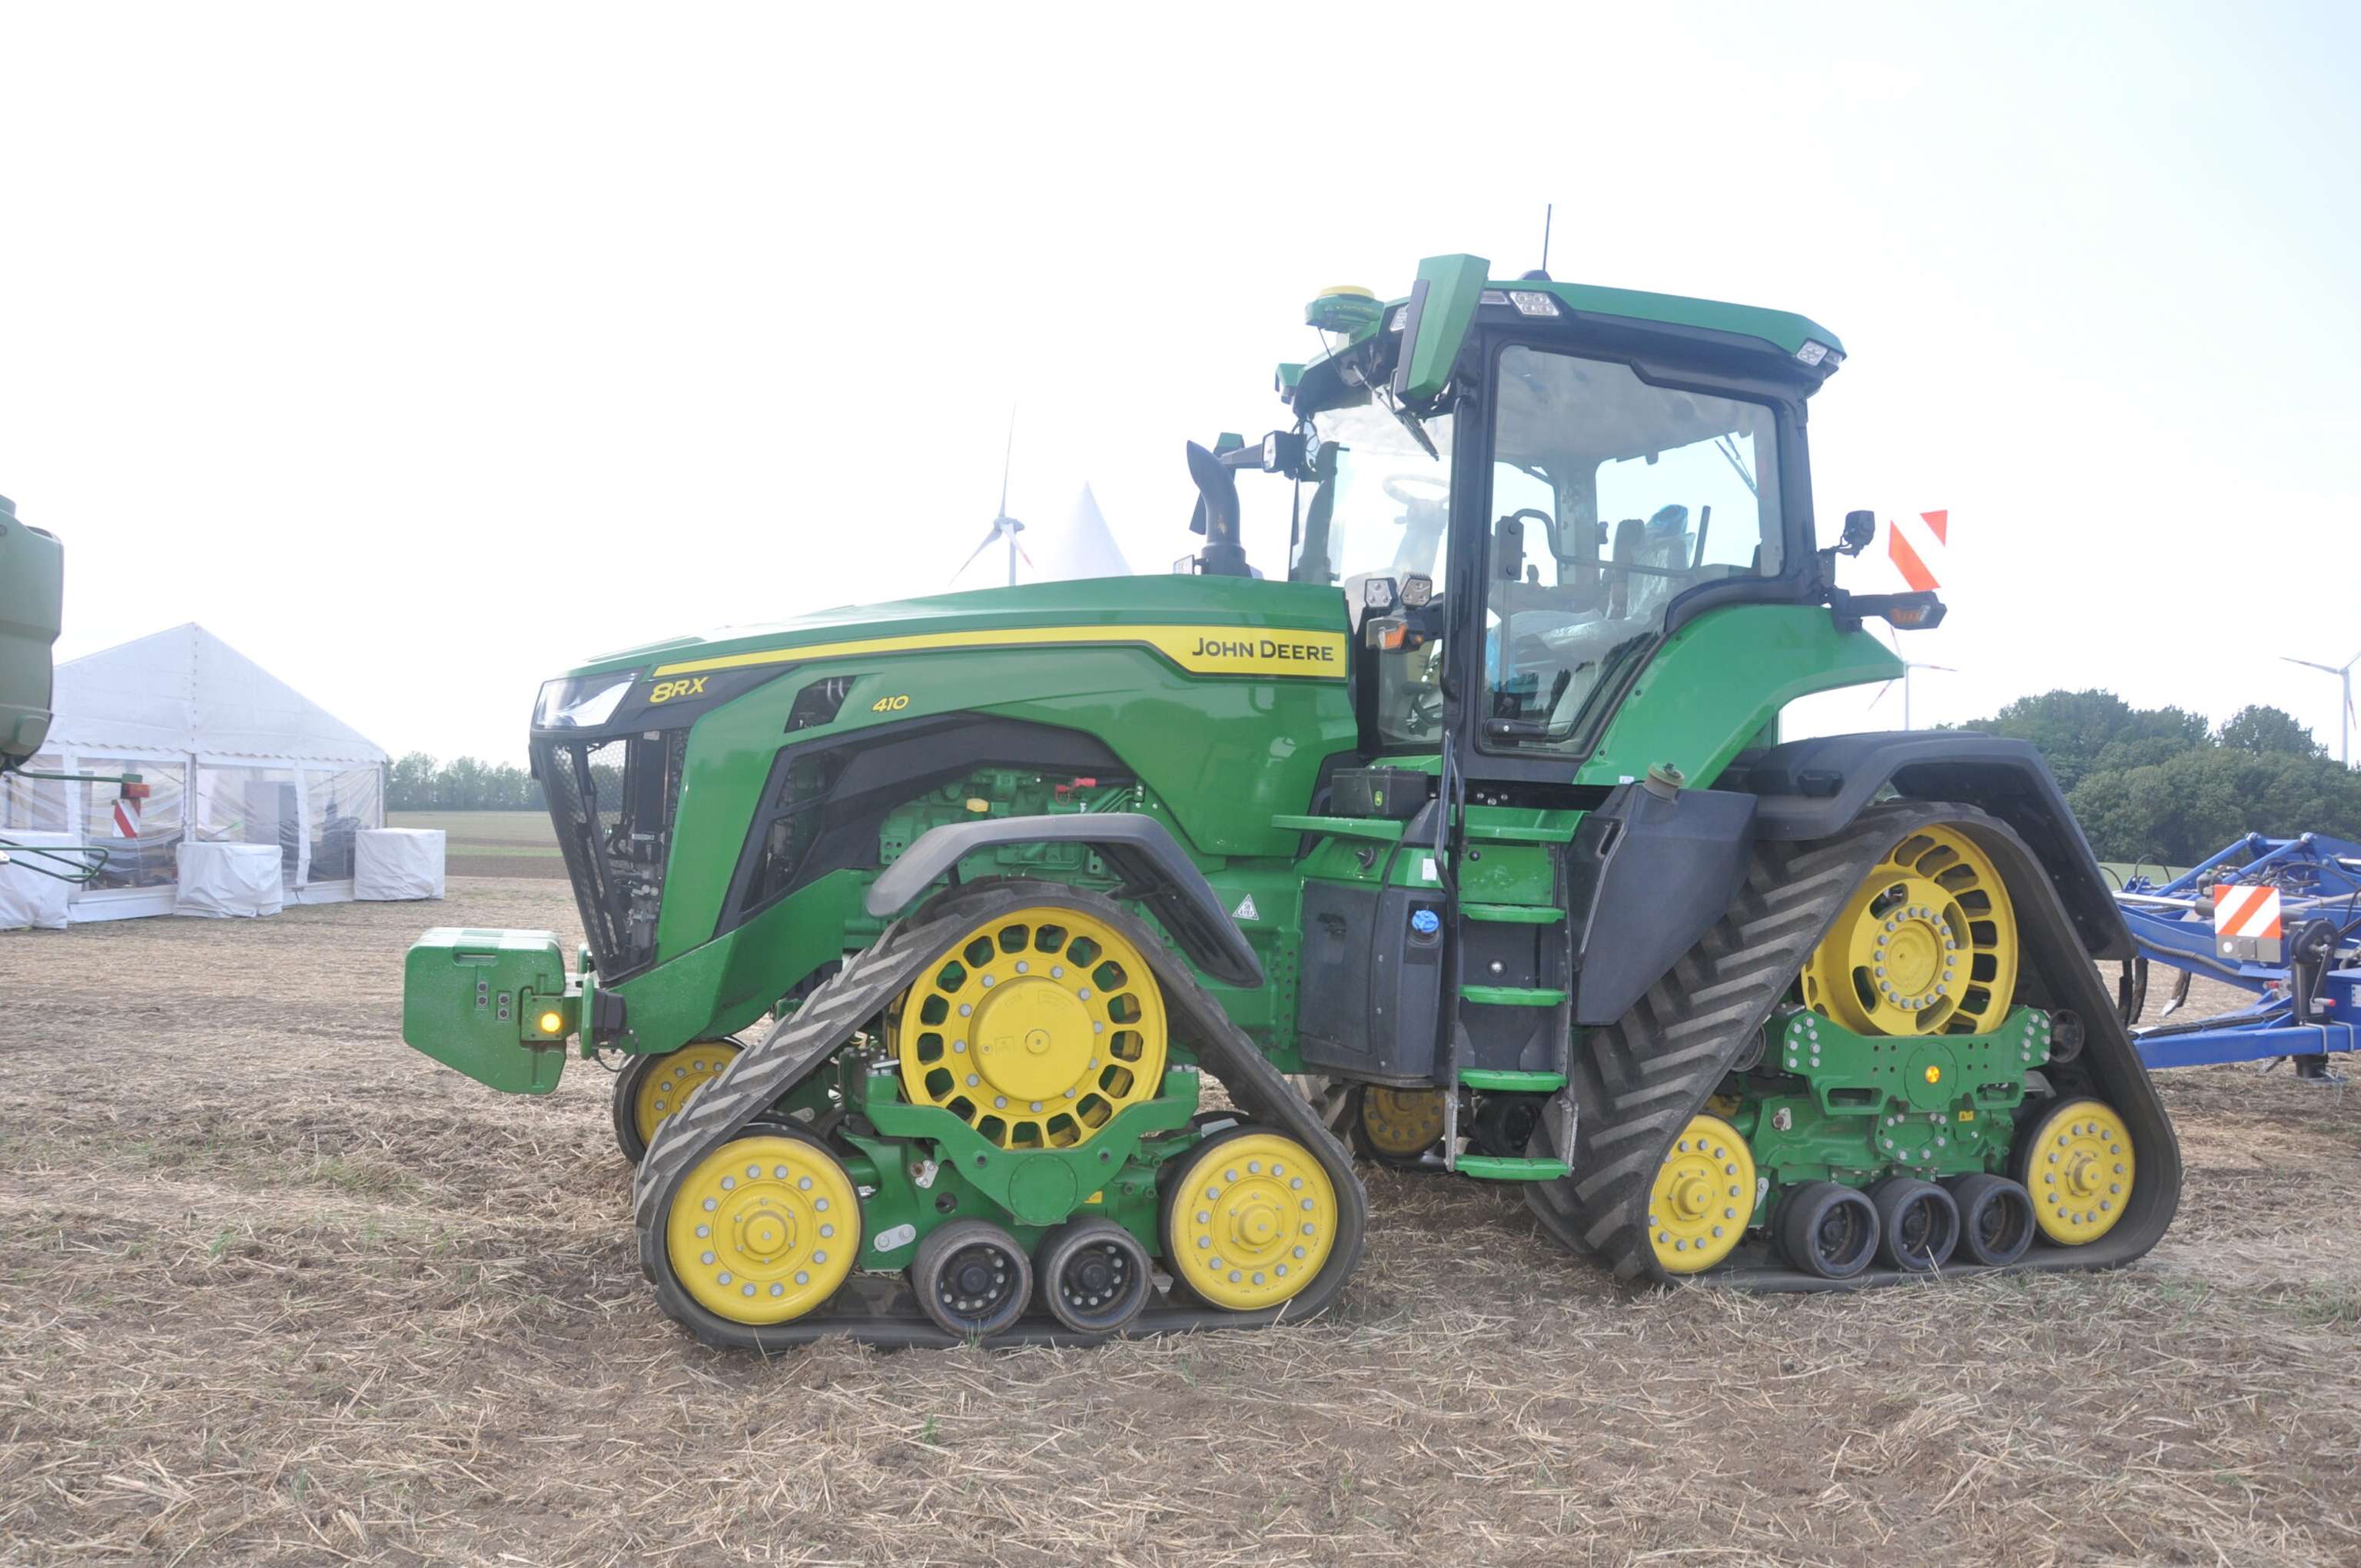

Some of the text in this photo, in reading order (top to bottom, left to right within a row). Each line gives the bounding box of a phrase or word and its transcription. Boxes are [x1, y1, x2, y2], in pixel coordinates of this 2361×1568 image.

[1192, 637, 1334, 662] JOHN DEERE
[649, 676, 709, 703] 8RX
[872, 694, 910, 712] 410
